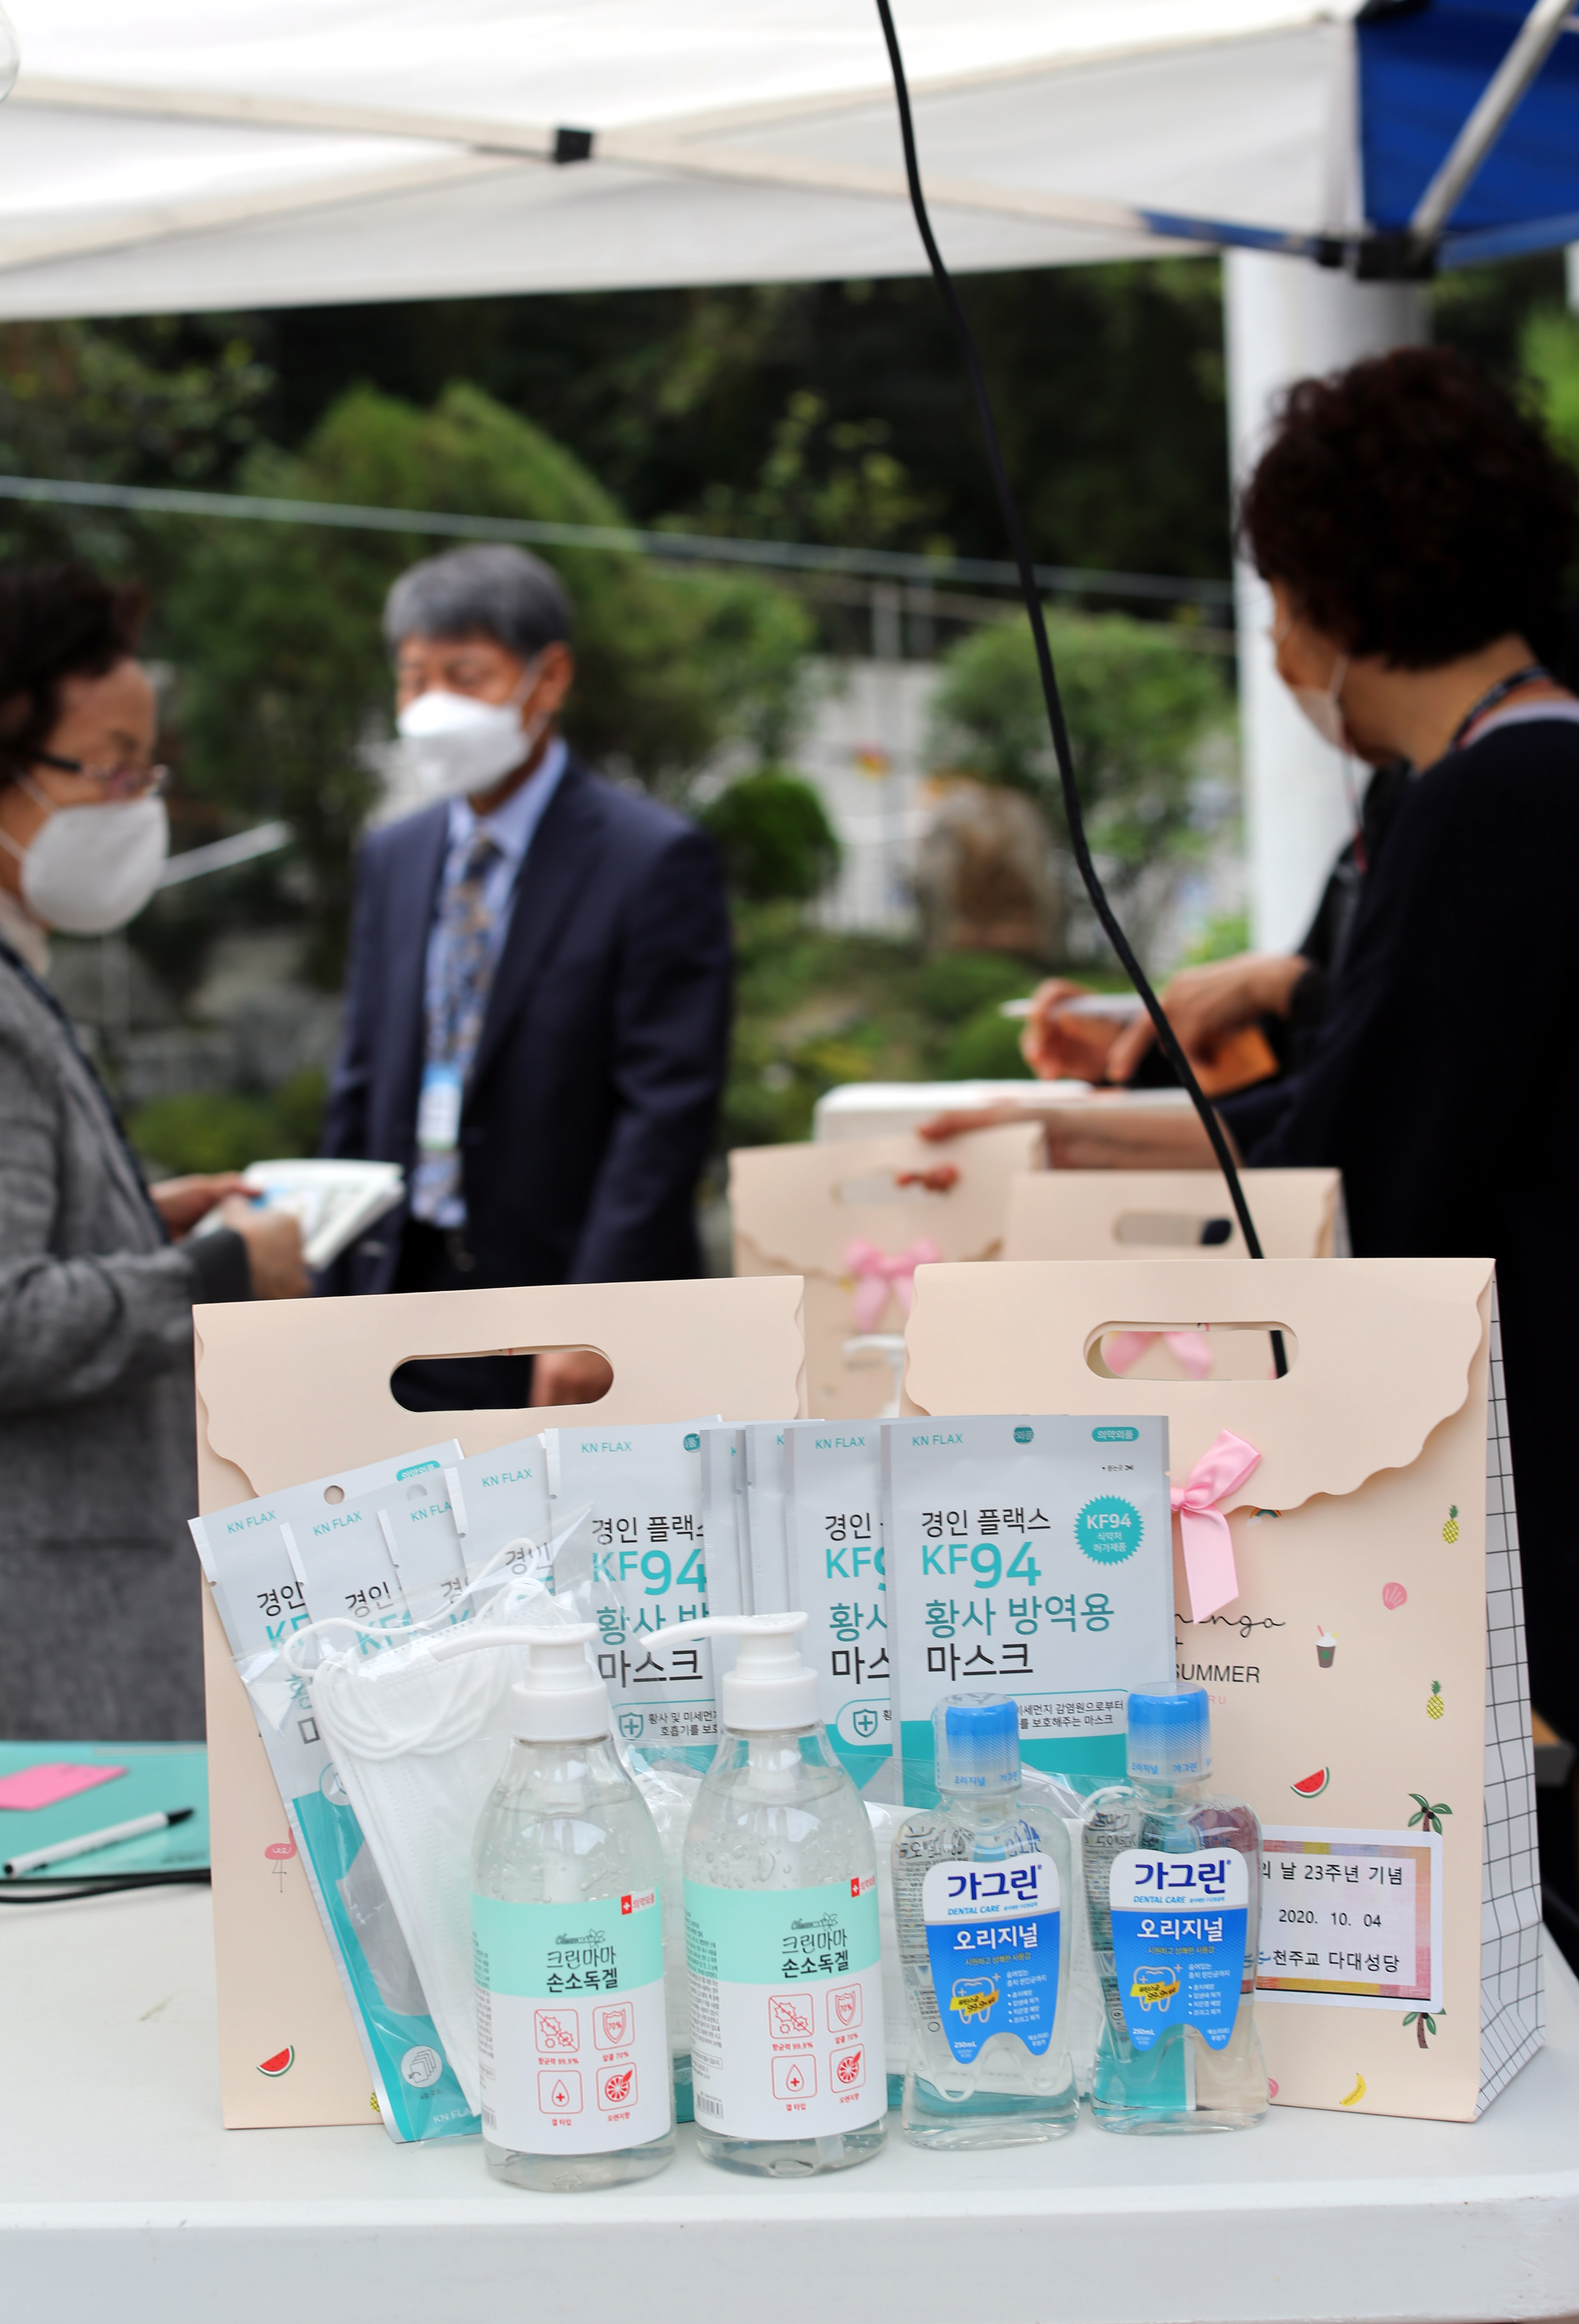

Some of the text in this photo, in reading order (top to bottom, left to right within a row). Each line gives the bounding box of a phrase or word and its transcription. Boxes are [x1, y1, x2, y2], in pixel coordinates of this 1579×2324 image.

[581, 1442, 632, 1453] KN FLAX
[815, 1436, 865, 1449] KN FLAX
[912, 1433, 963, 1446] KN FLAX
[1097, 1430, 1134, 1440] 의약외품
[482, 1468, 533, 1487] KN FLAX
[227, 1510, 277, 1534] KN FLAX
[313, 1511, 363, 1536] KN FLAX
[410, 1502, 451, 1522] KN FLA
[922, 1507, 1051, 1537] 경인 플랙스
[1086, 1513, 1132, 1530] KF94
[592, 1516, 638, 1545] 경인
[825, 1512, 872, 1541] 경인
[1097, 1531, 1122, 1541] 식약처
[1093, 1542, 1127, 1553] 허가제품
[593, 1549, 706, 1595] KF94
[922, 1542, 1042, 1589] KF94
[257, 1581, 306, 1616] 경인
[345, 1581, 394, 1618] 경인
[596, 1604, 666, 1646] 황사
[925, 1593, 1115, 1638] 황사 방역용
[598, 1649, 703, 1688] 마스크
[832, 1646, 890, 1684] 마스
[927, 1643, 1033, 1681] 마스크
[648, 1713, 668, 1724] 황사
[671, 1712, 680, 1723] 및
[1056, 1700, 1124, 1714] 감염원으로부터
[660, 1724, 699, 1736] 호흡기를
[1032, 1716, 1081, 1728] 보호해주는
[1084, 1714, 1113, 1726] 마스크
[948, 1865, 1038, 1900] 가그린
[1135, 1860, 1225, 1894] 가그린
[1281, 1862, 1296, 1880] 날
[1304, 1864, 1359, 1883] 23주년
[1368, 1866, 1402, 1885] 기념
[1137, 1917, 1222, 1942] 오리지널
[1278, 1909, 1382, 1927] 2020. 10. 04
[782, 1928, 847, 1953] 크린마마
[953, 1922, 1038, 1950] 오리지널
[547, 1946, 616, 1969] 크린마마
[782, 1950, 849, 1978] 손소독겔
[1273, 1950, 1400, 1972] 천주교 다대성당
[547, 1968, 618, 1993] 손소독겔
[433, 2107, 471, 2123] KN FLA
